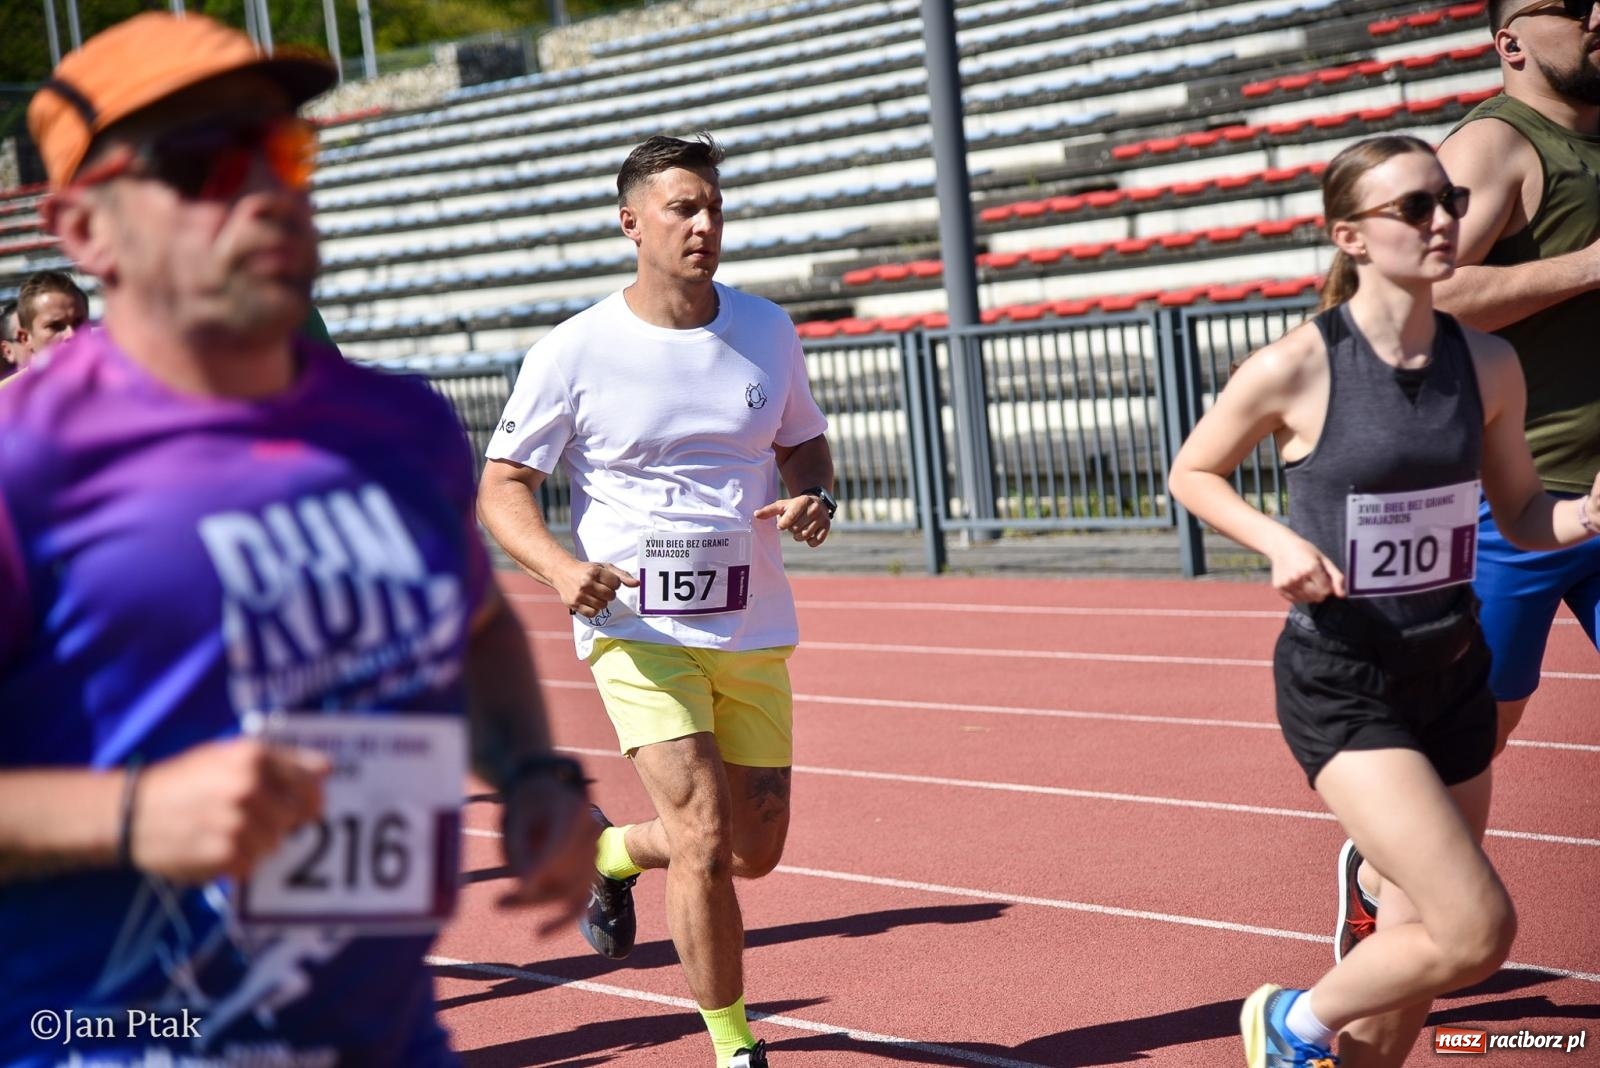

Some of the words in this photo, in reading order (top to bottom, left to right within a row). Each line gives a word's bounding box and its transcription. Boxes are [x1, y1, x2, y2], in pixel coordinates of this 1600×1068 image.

[1358, 503, 1382, 514] XVIII
[1383, 501, 1405, 512] BIEG
[1407, 499, 1423, 511] BEZ
[1425, 494, 1455, 508] GRANIC
[1357, 513, 1411, 526] 3MAJA2026
[645, 539, 664, 548] XVIII
[666, 539, 684, 548] BIEG
[686, 539, 700, 548] BEZ
[701, 538, 730, 548] GRANIC
[645, 549, 690, 558] 3MAJA2026
[1371, 534, 1438, 577] 210
[658, 570, 717, 602] 157
[283, 809, 412, 892] 216
